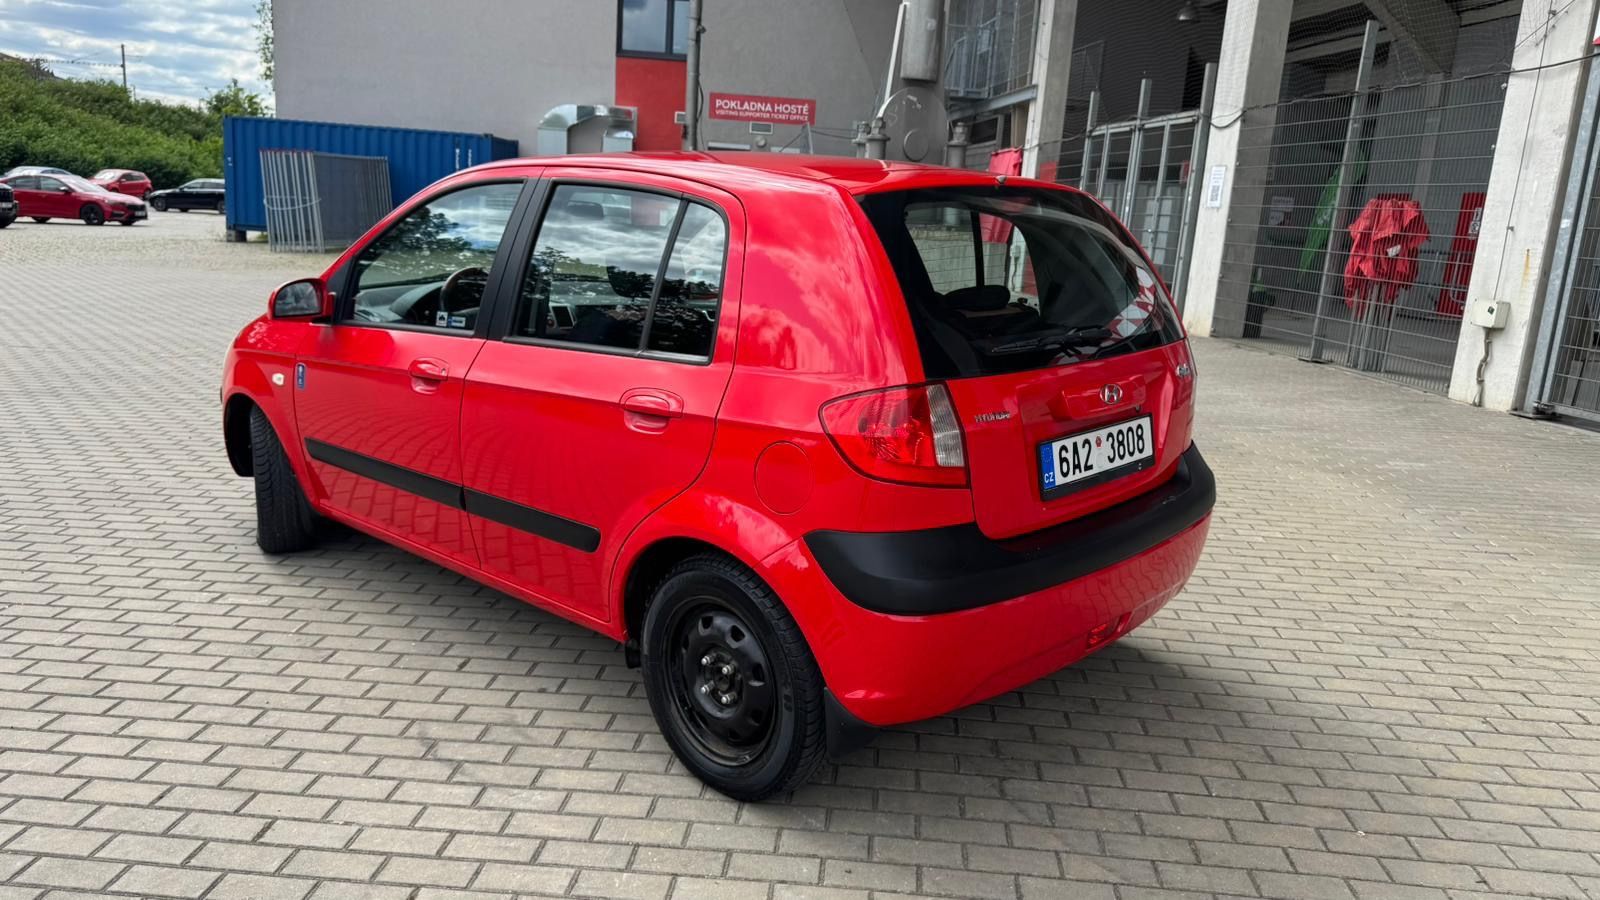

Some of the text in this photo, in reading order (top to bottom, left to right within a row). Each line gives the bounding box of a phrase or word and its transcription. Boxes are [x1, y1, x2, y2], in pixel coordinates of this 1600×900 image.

[715, 99, 809, 115] POKLADNA HOSTÉ
[739, 111, 770, 119] SUPPORTER
[1059, 423, 1145, 478] 6A2 3808
[1044, 471, 1054, 484] CZ
